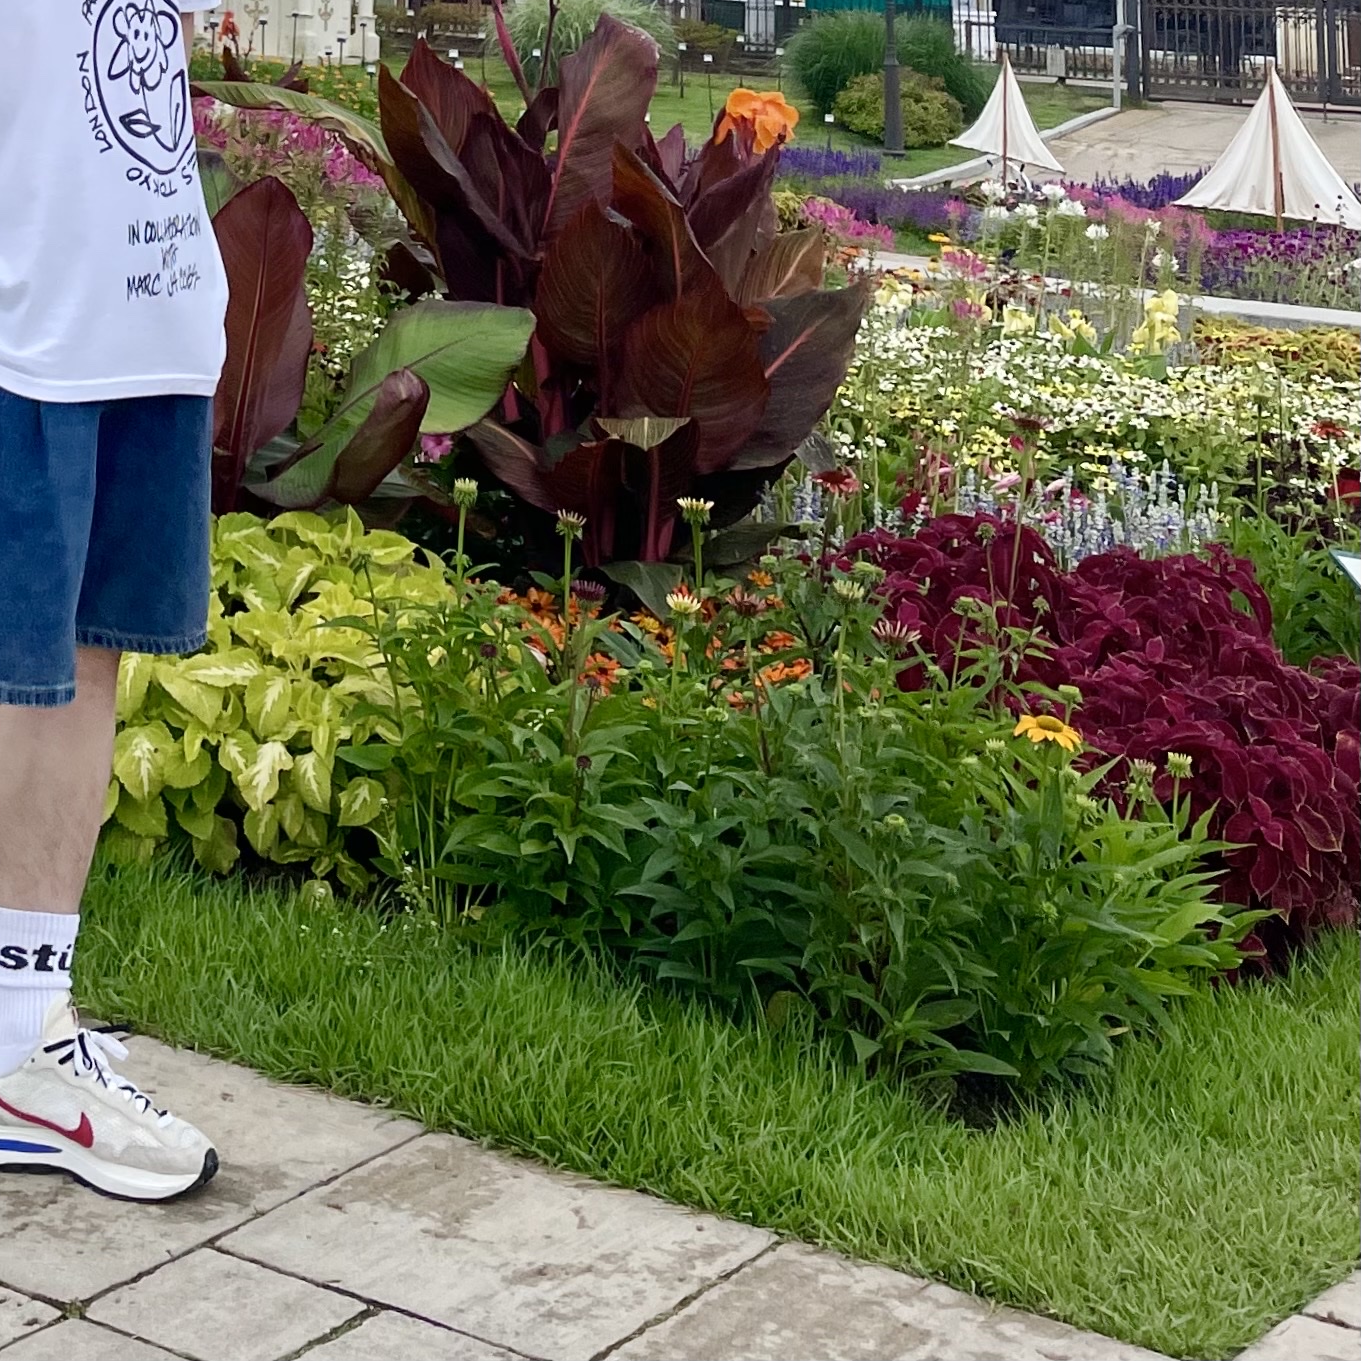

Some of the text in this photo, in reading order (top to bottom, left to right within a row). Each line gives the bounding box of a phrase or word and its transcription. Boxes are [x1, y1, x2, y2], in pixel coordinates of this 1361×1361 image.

[76, 51, 113, 153] LONDON
[126, 167, 178, 198] TOKYO
[128, 219, 141, 246] IN
[126, 273, 161, 302] MARC
